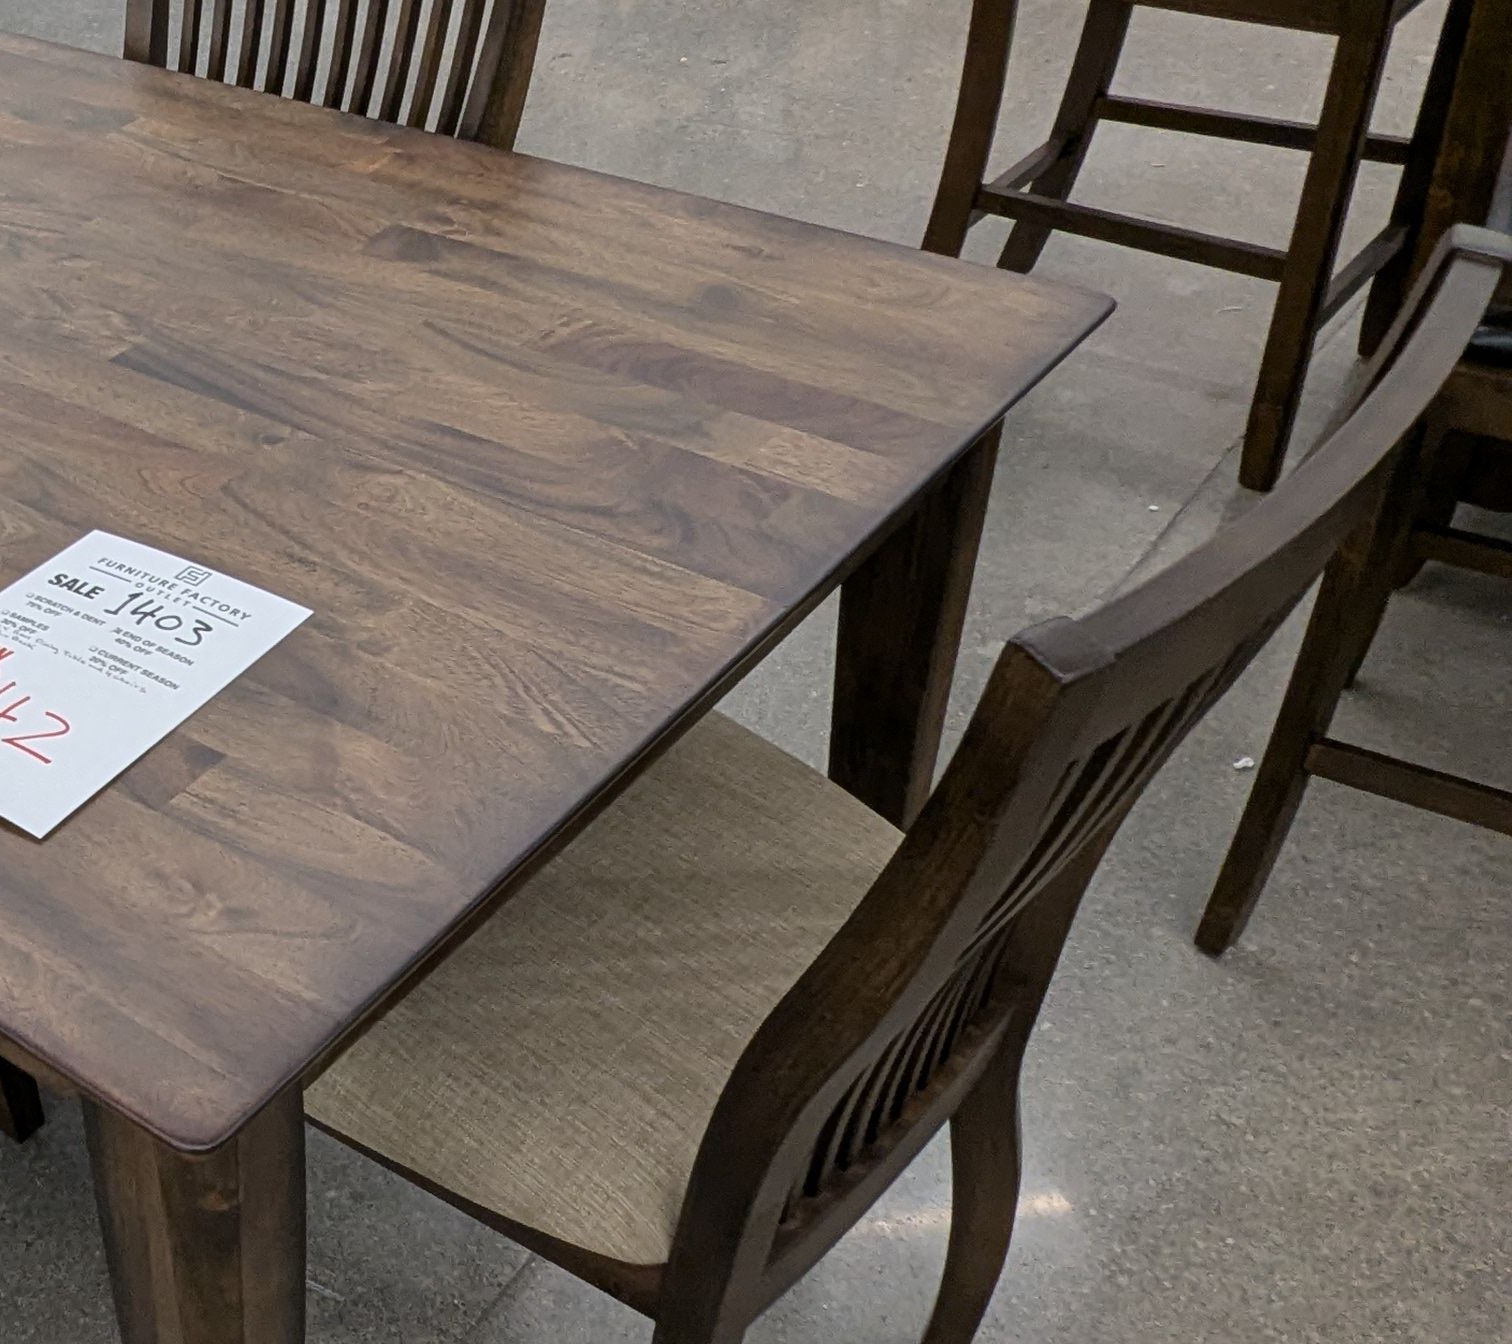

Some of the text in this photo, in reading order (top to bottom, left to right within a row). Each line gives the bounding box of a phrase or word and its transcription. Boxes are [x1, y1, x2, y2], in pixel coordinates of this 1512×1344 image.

[97, 558, 252, 621] FURNITURE FACTORY
[135, 582, 191, 607] OUTLET
[9, 612, 50, 631] SAMPLES
[35, 595, 74, 613] SCRATCH
[81, 613, 106, 626] DENT
[43, 607, 62, 616] OFF
[48, 573, 213, 646] SALE 1403
[19, 625, 38, 634] OFF
[122, 631, 194, 666] END OF SEASON
[133, 646, 153, 655] OFF
[98, 649, 180, 690] CURRENT SEASON
[108, 664, 128, 675] OFF
